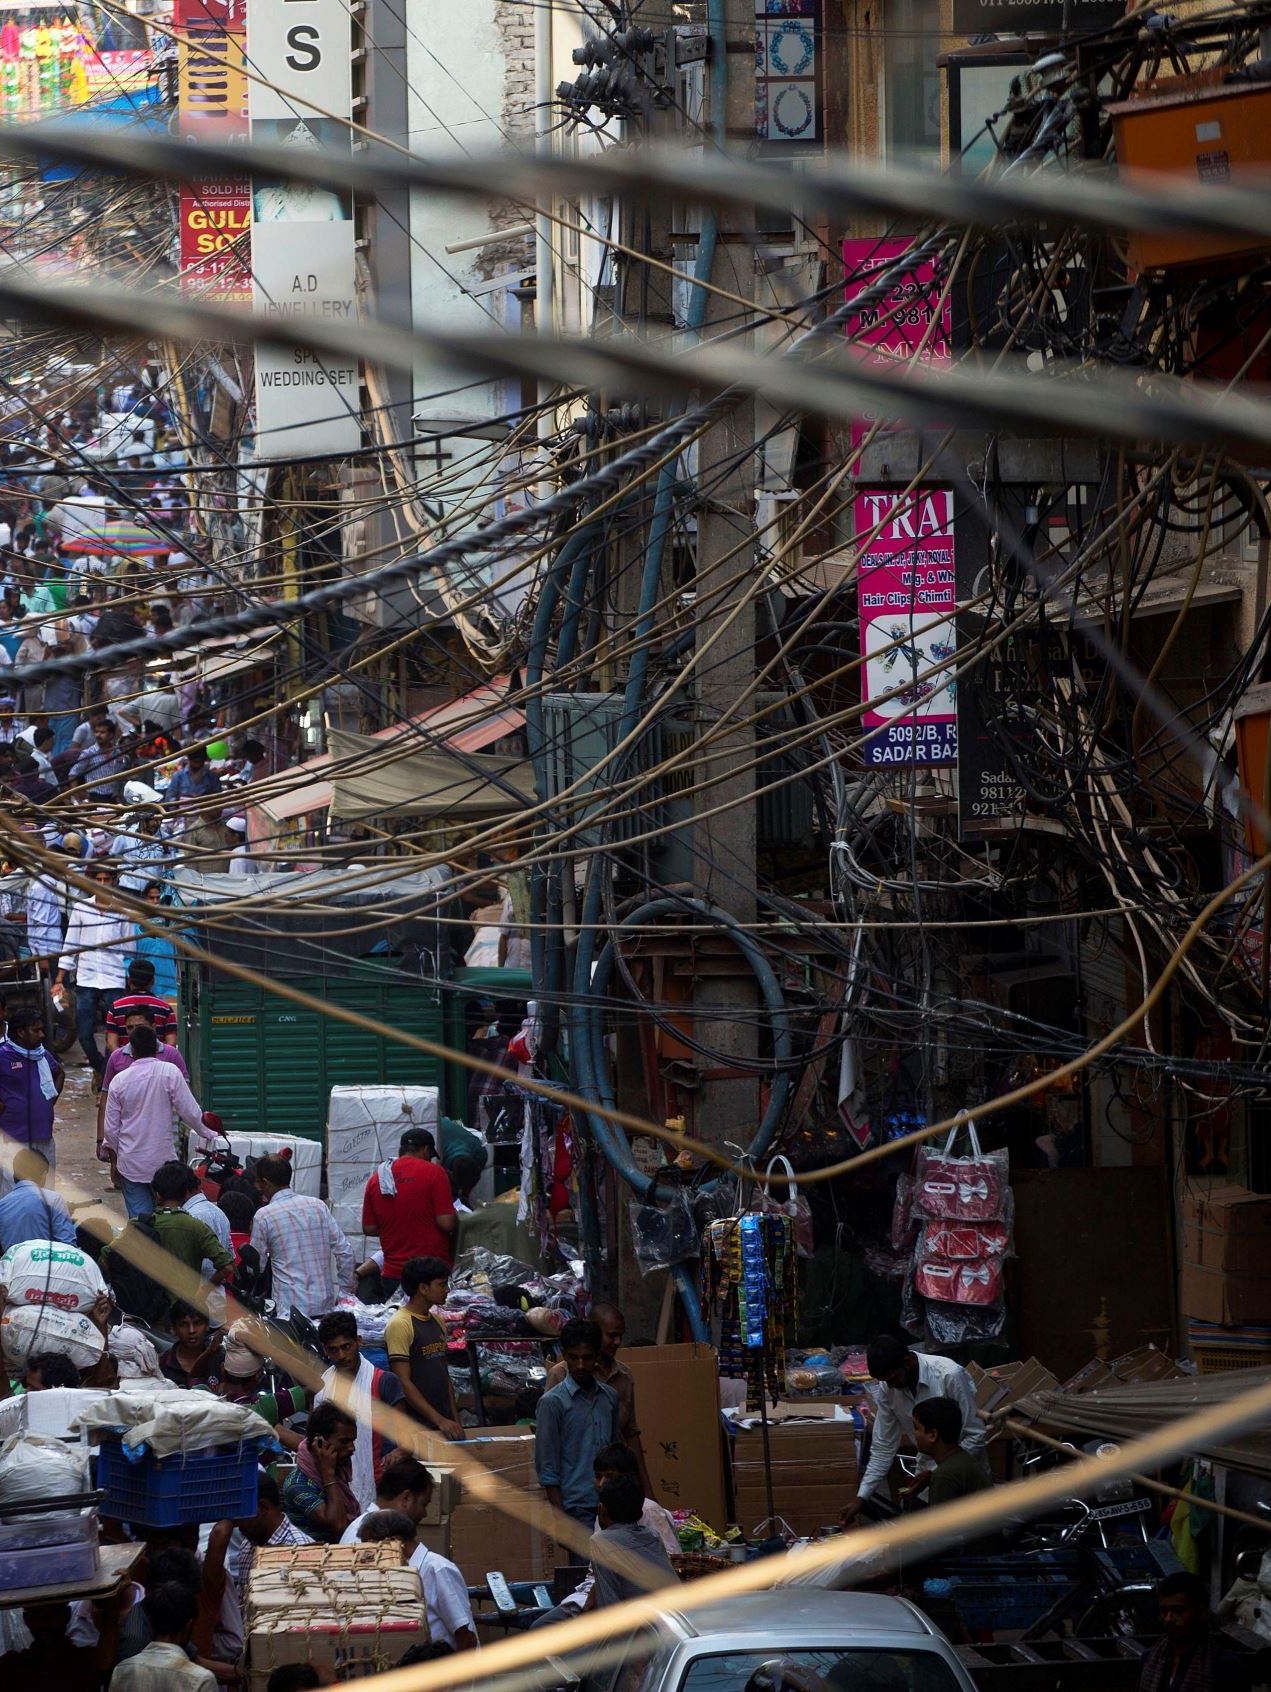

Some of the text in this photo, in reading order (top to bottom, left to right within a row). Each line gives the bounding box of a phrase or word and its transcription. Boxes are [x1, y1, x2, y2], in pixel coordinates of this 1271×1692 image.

[202, 185, 232, 195] SOLD
[292, 275, 318, 293] A.D
[264, 301, 353, 321] JEWELLERY
[261, 370, 354, 387] WEDDING SET
[928, 550, 950, 565] ROYAL
[927, 572, 935, 584] &
[863, 594, 884, 606] Hair
[918, 590, 952, 603] Chimti
[872, 745, 927, 763] SADAR
[278, 1015, 297, 1023] CNG
